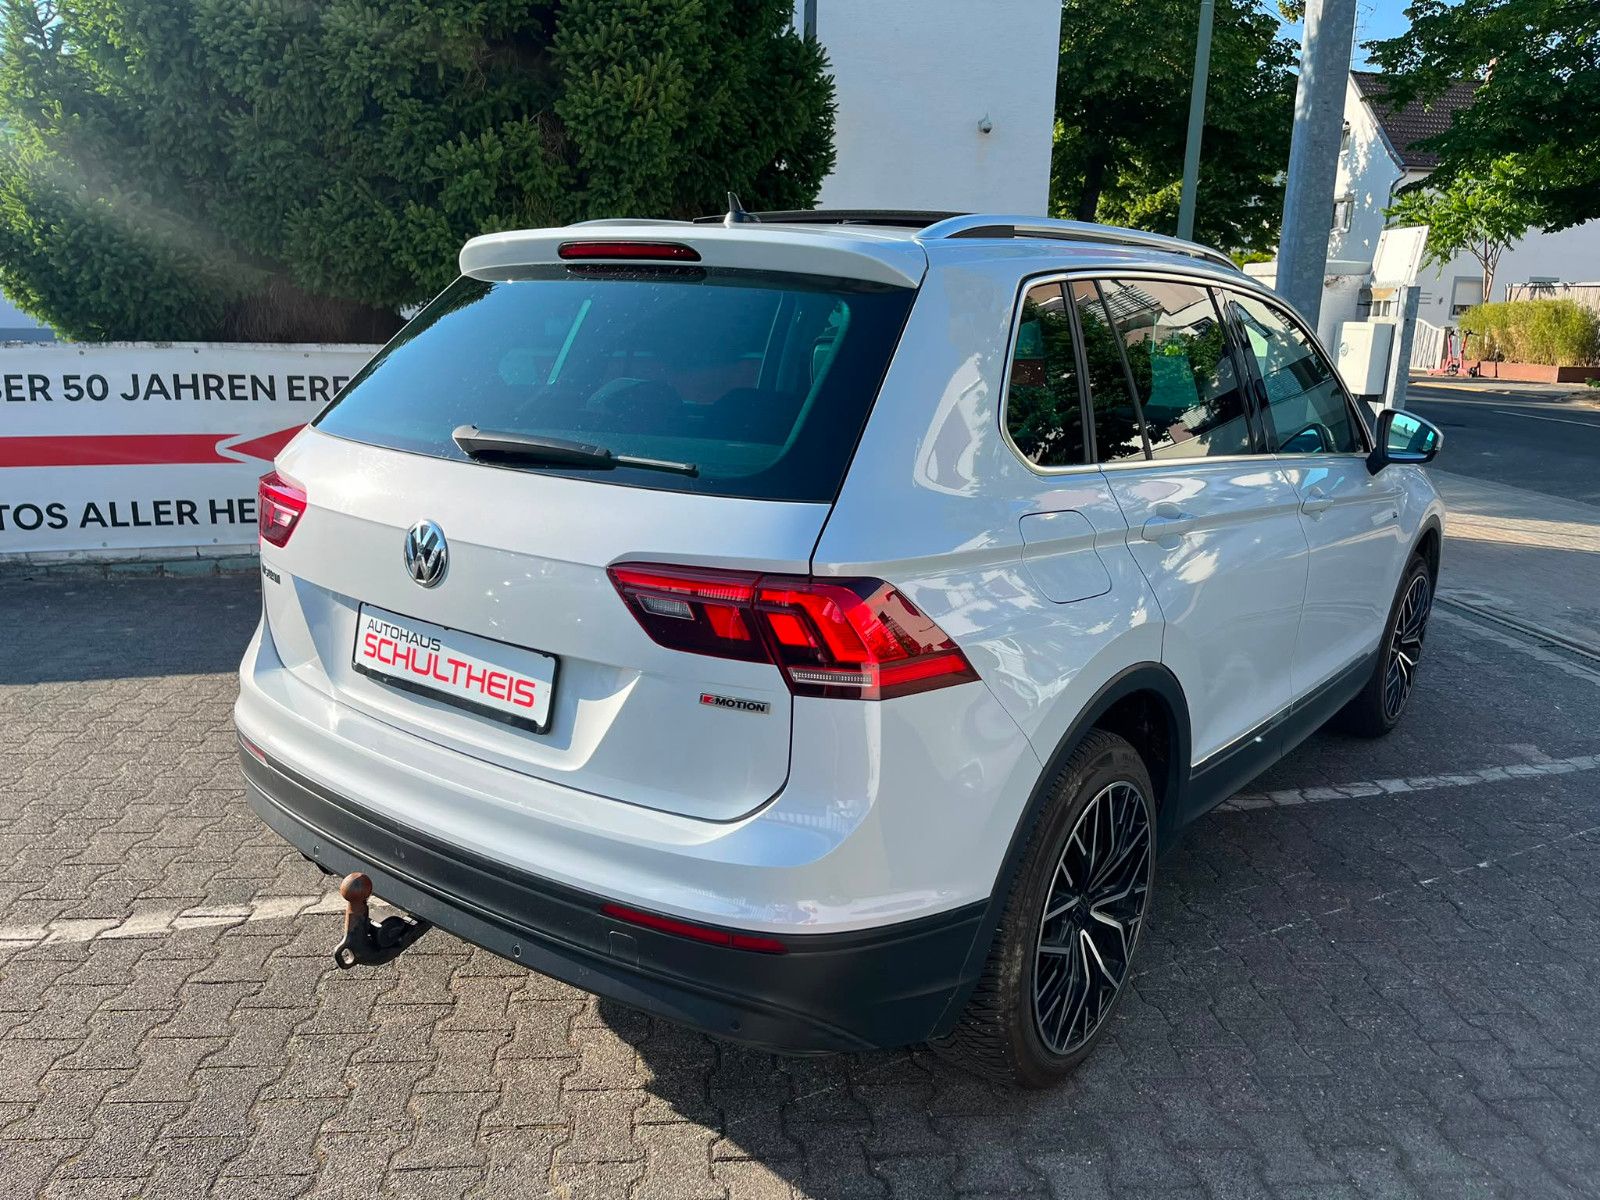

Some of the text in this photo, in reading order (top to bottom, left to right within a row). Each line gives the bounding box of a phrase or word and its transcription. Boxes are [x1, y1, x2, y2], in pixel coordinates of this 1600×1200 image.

[0, 374, 53, 402] ER
[62, 374, 109, 402] 50
[120, 373, 276, 402] JAHREN
[80, 499, 199, 529] ALLER
[208, 498, 258, 525] HE
[367, 618, 441, 652] AUTOHAUS
[364, 632, 536, 708] SCHULTHEIS
